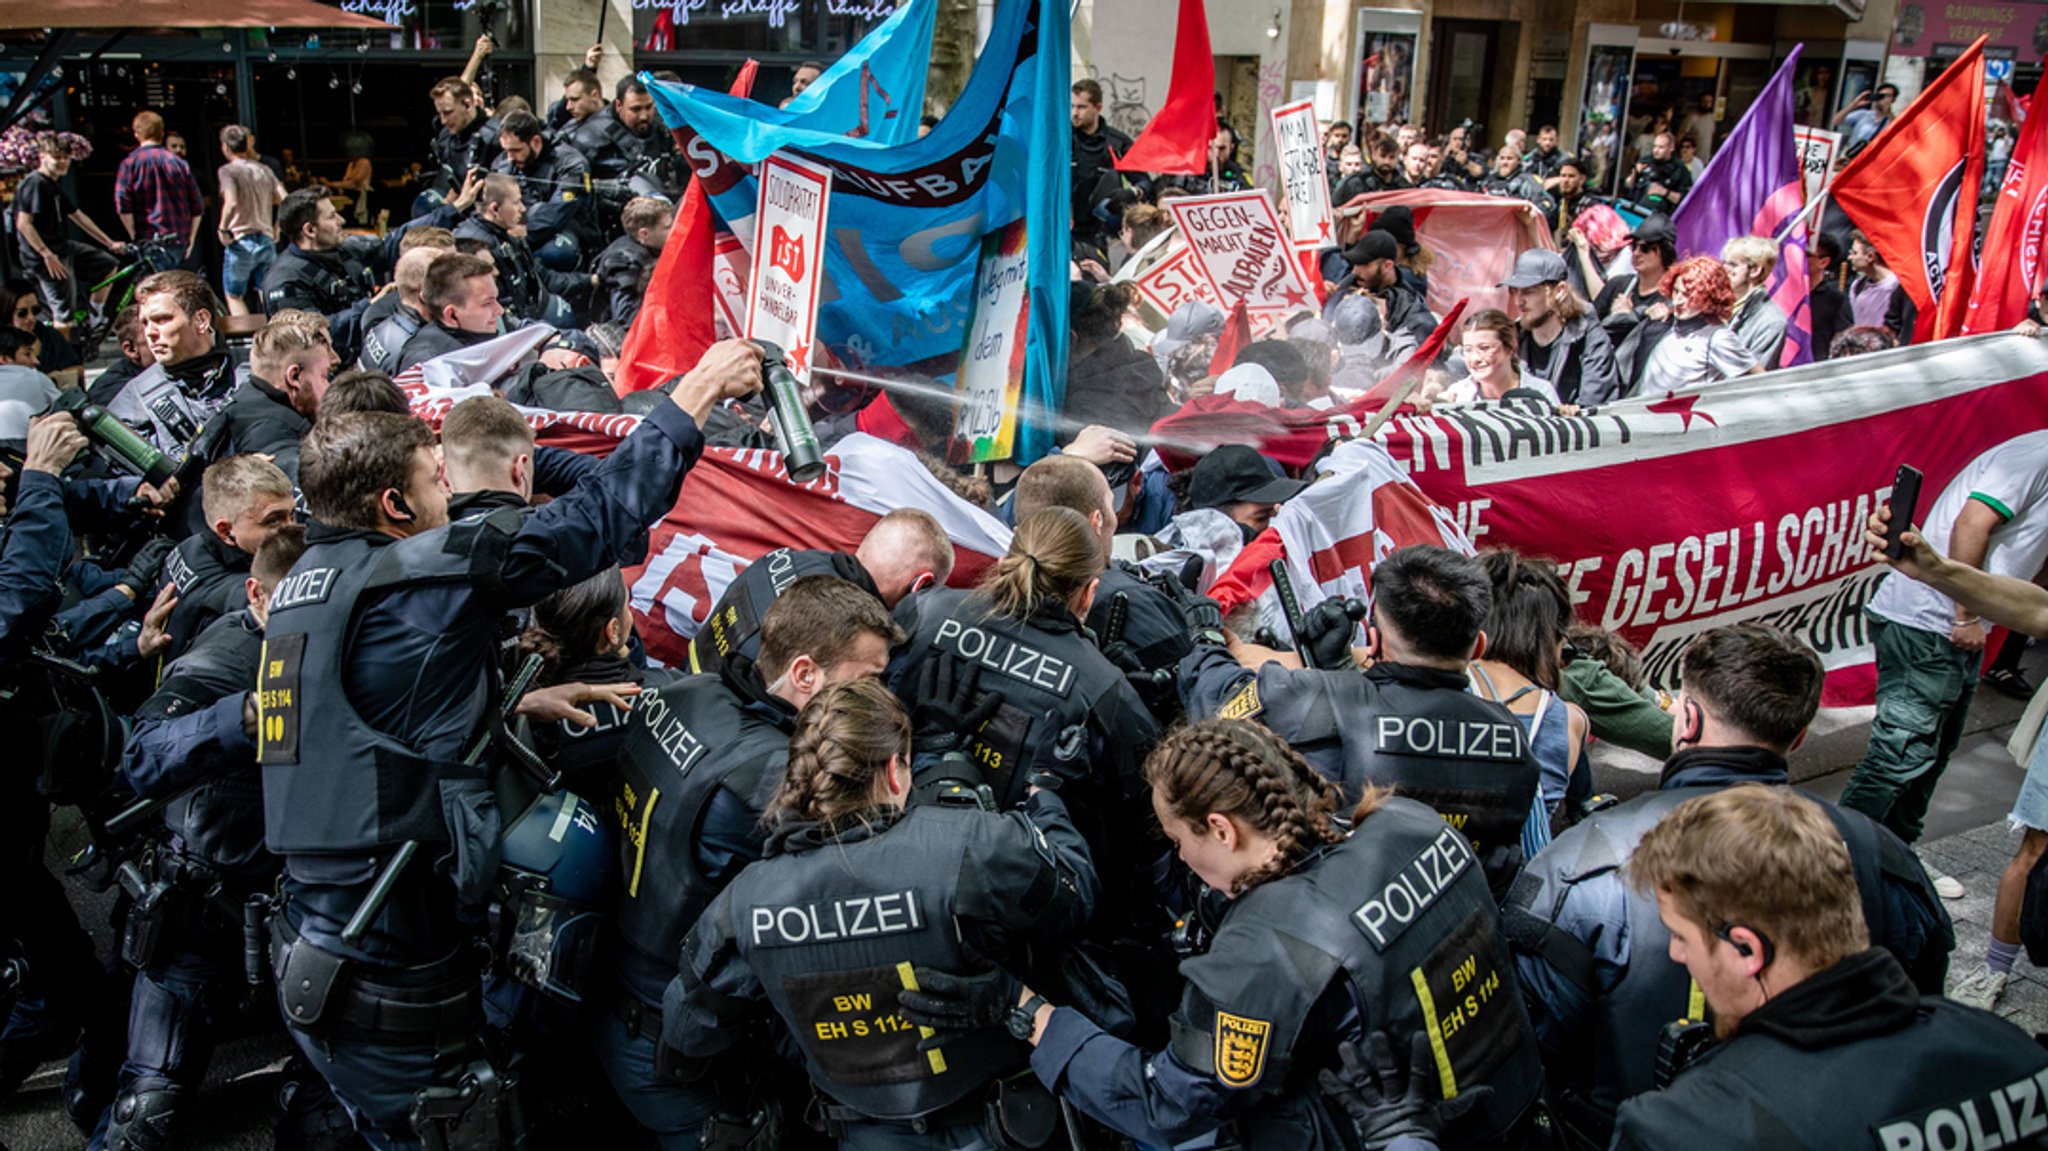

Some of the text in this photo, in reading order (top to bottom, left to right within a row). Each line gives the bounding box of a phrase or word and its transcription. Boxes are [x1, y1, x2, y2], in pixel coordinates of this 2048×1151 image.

[1186, 205, 1255, 232] GEGEN-
[1196, 232, 1247, 255] MACHT
[975, 319, 1003, 361] dem
[934, 618, 1073, 692] POLIZEI
[639, 687, 703, 771] POLIZEI
[1378, 716, 1522, 758] POLIZEI
[1355, 827, 1471, 945] POLIZEI
[752, 890, 919, 945] POLIZEI
[1451, 954, 1477, 993] BW
[833, 993, 872, 1012] BW
[1441, 1005, 1466, 1040] EH
[1464, 994, 1480, 1018] S
[815, 1022, 849, 1041] EH
[853, 1019, 870, 1036] S
[1221, 1016, 1264, 1036] POLIZEI
